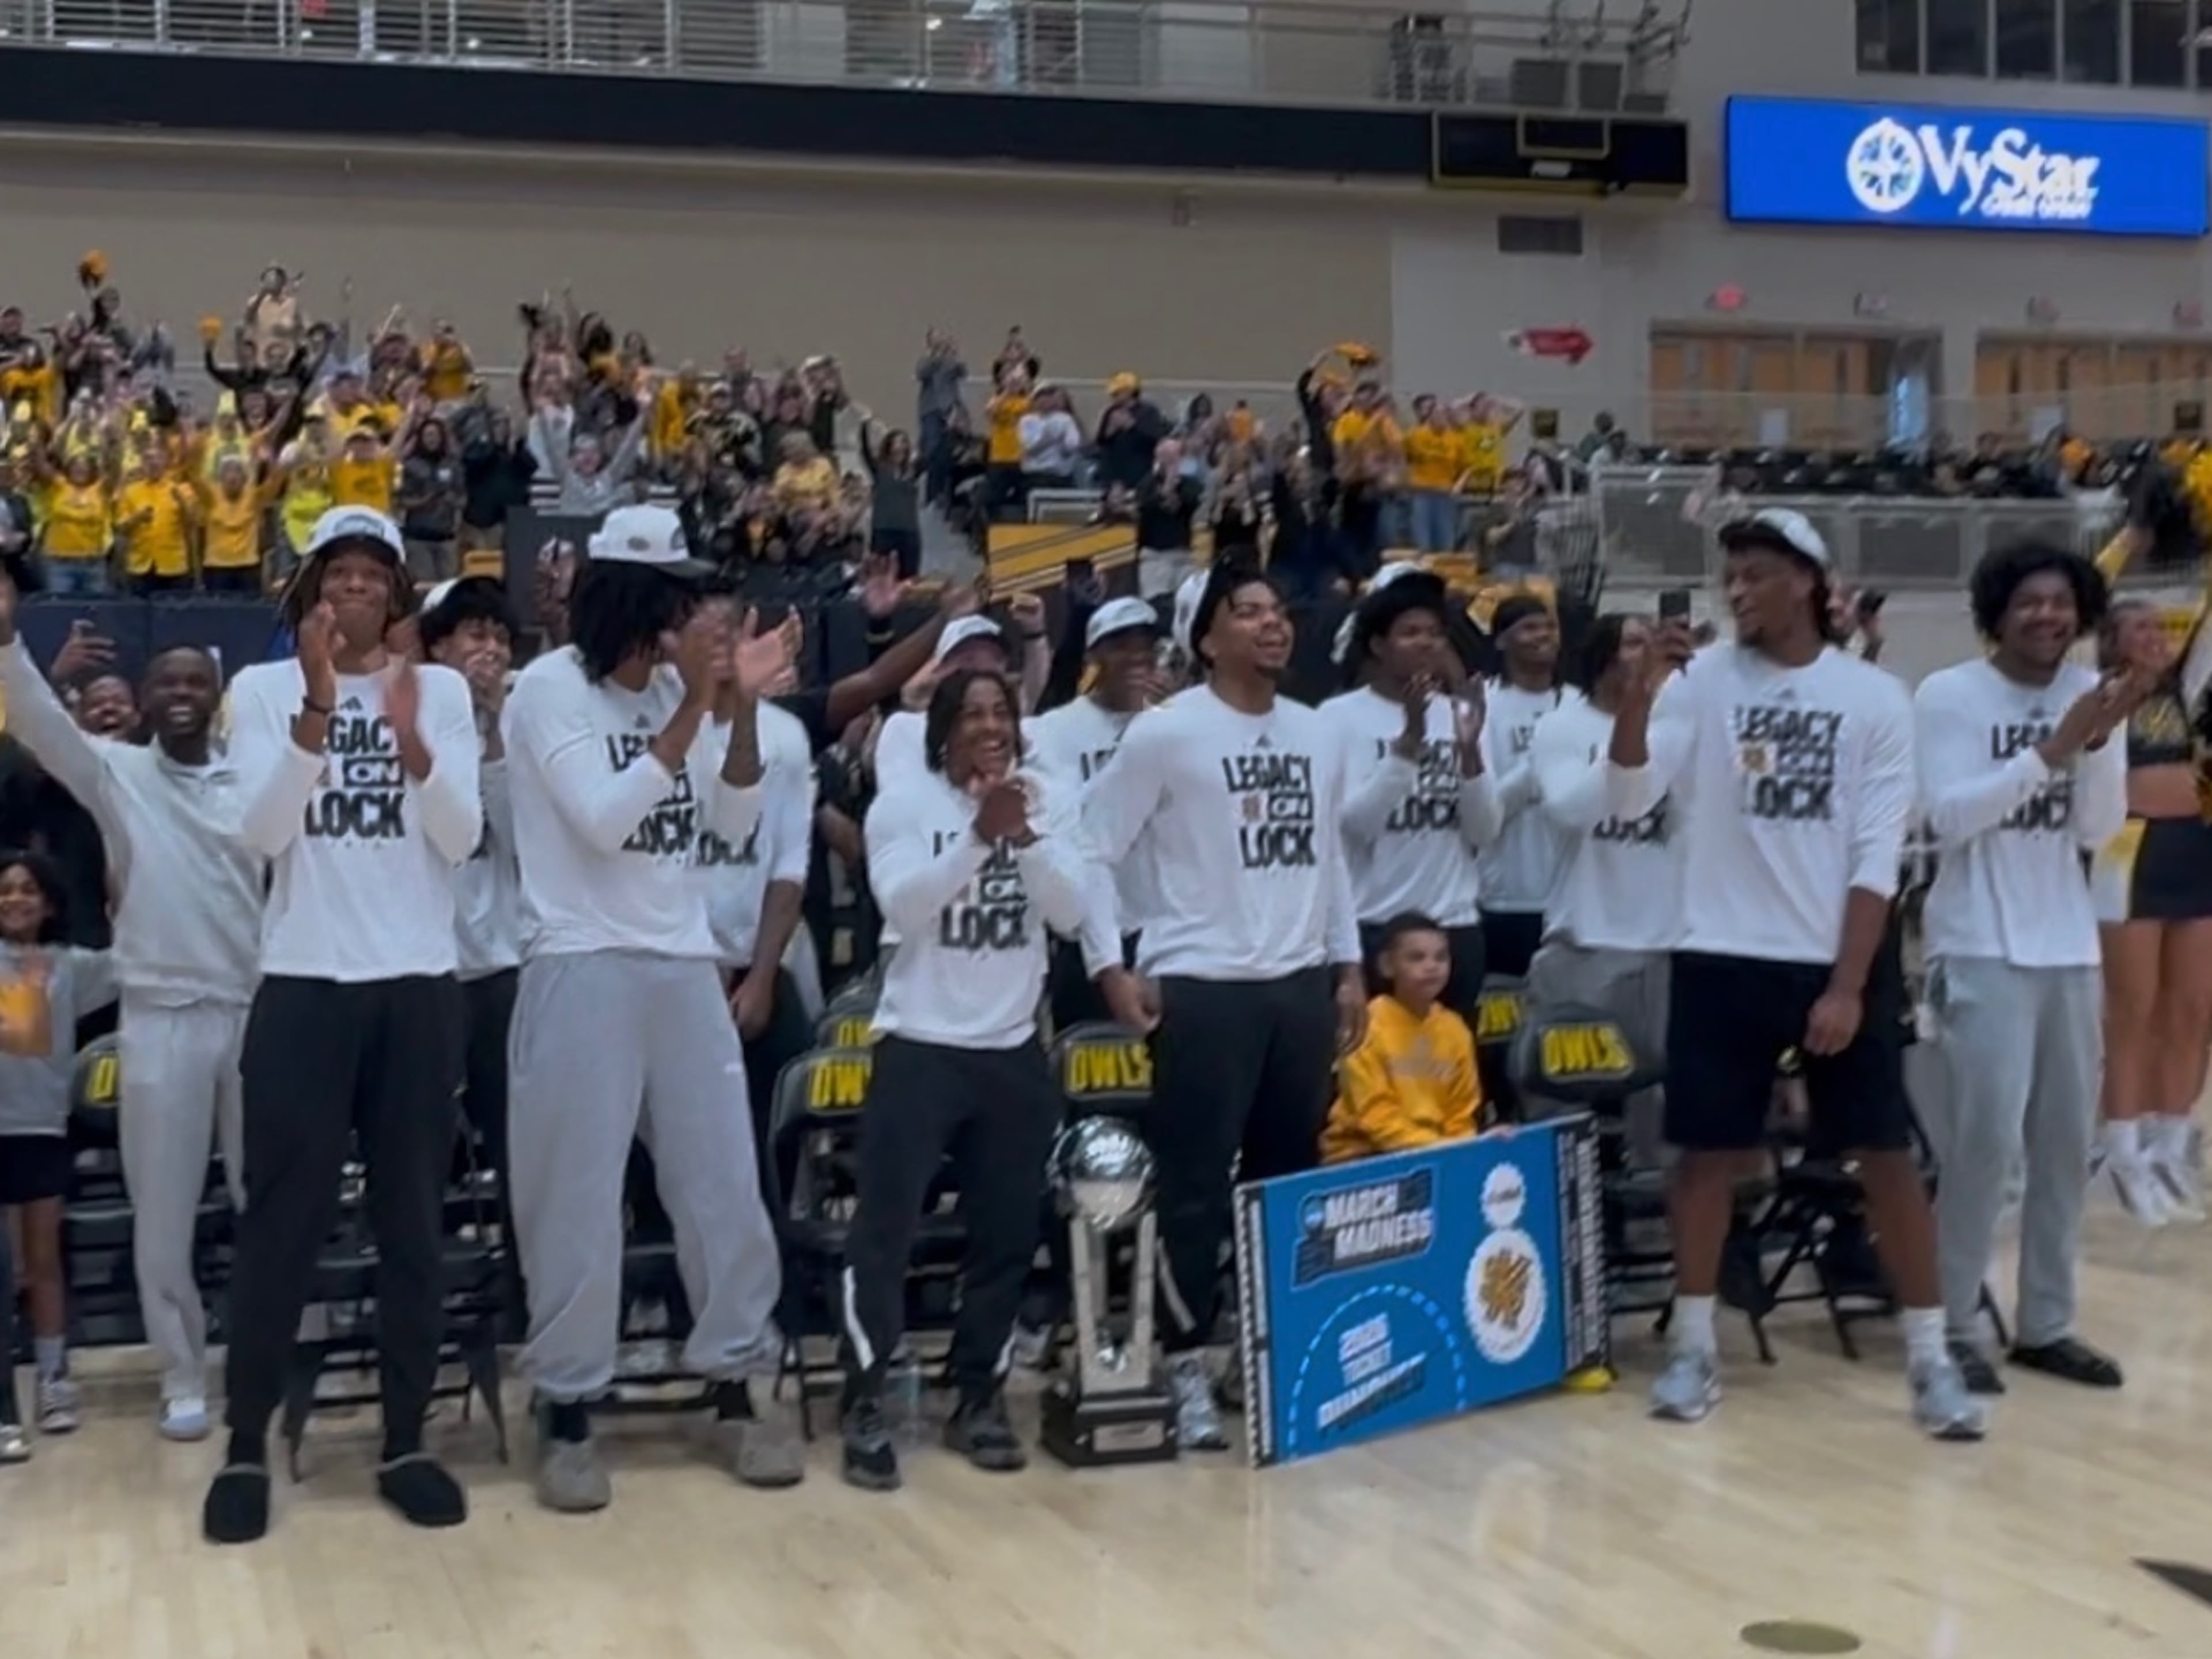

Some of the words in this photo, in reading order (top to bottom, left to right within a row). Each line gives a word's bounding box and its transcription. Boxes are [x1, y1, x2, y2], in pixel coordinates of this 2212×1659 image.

[1918, 124, 2101, 215] VyStar
[1222, 753, 1311, 793] LEGACY
[304, 791, 406, 838] LOCK
[1240, 825, 1316, 868] LOCK
[810, 1054, 871, 1107] OW
[1069, 1044, 1151, 1093] OWLS
[1325, 1183, 1399, 1230] MARCH
[1334, 1208, 1434, 1260] MADNESS
